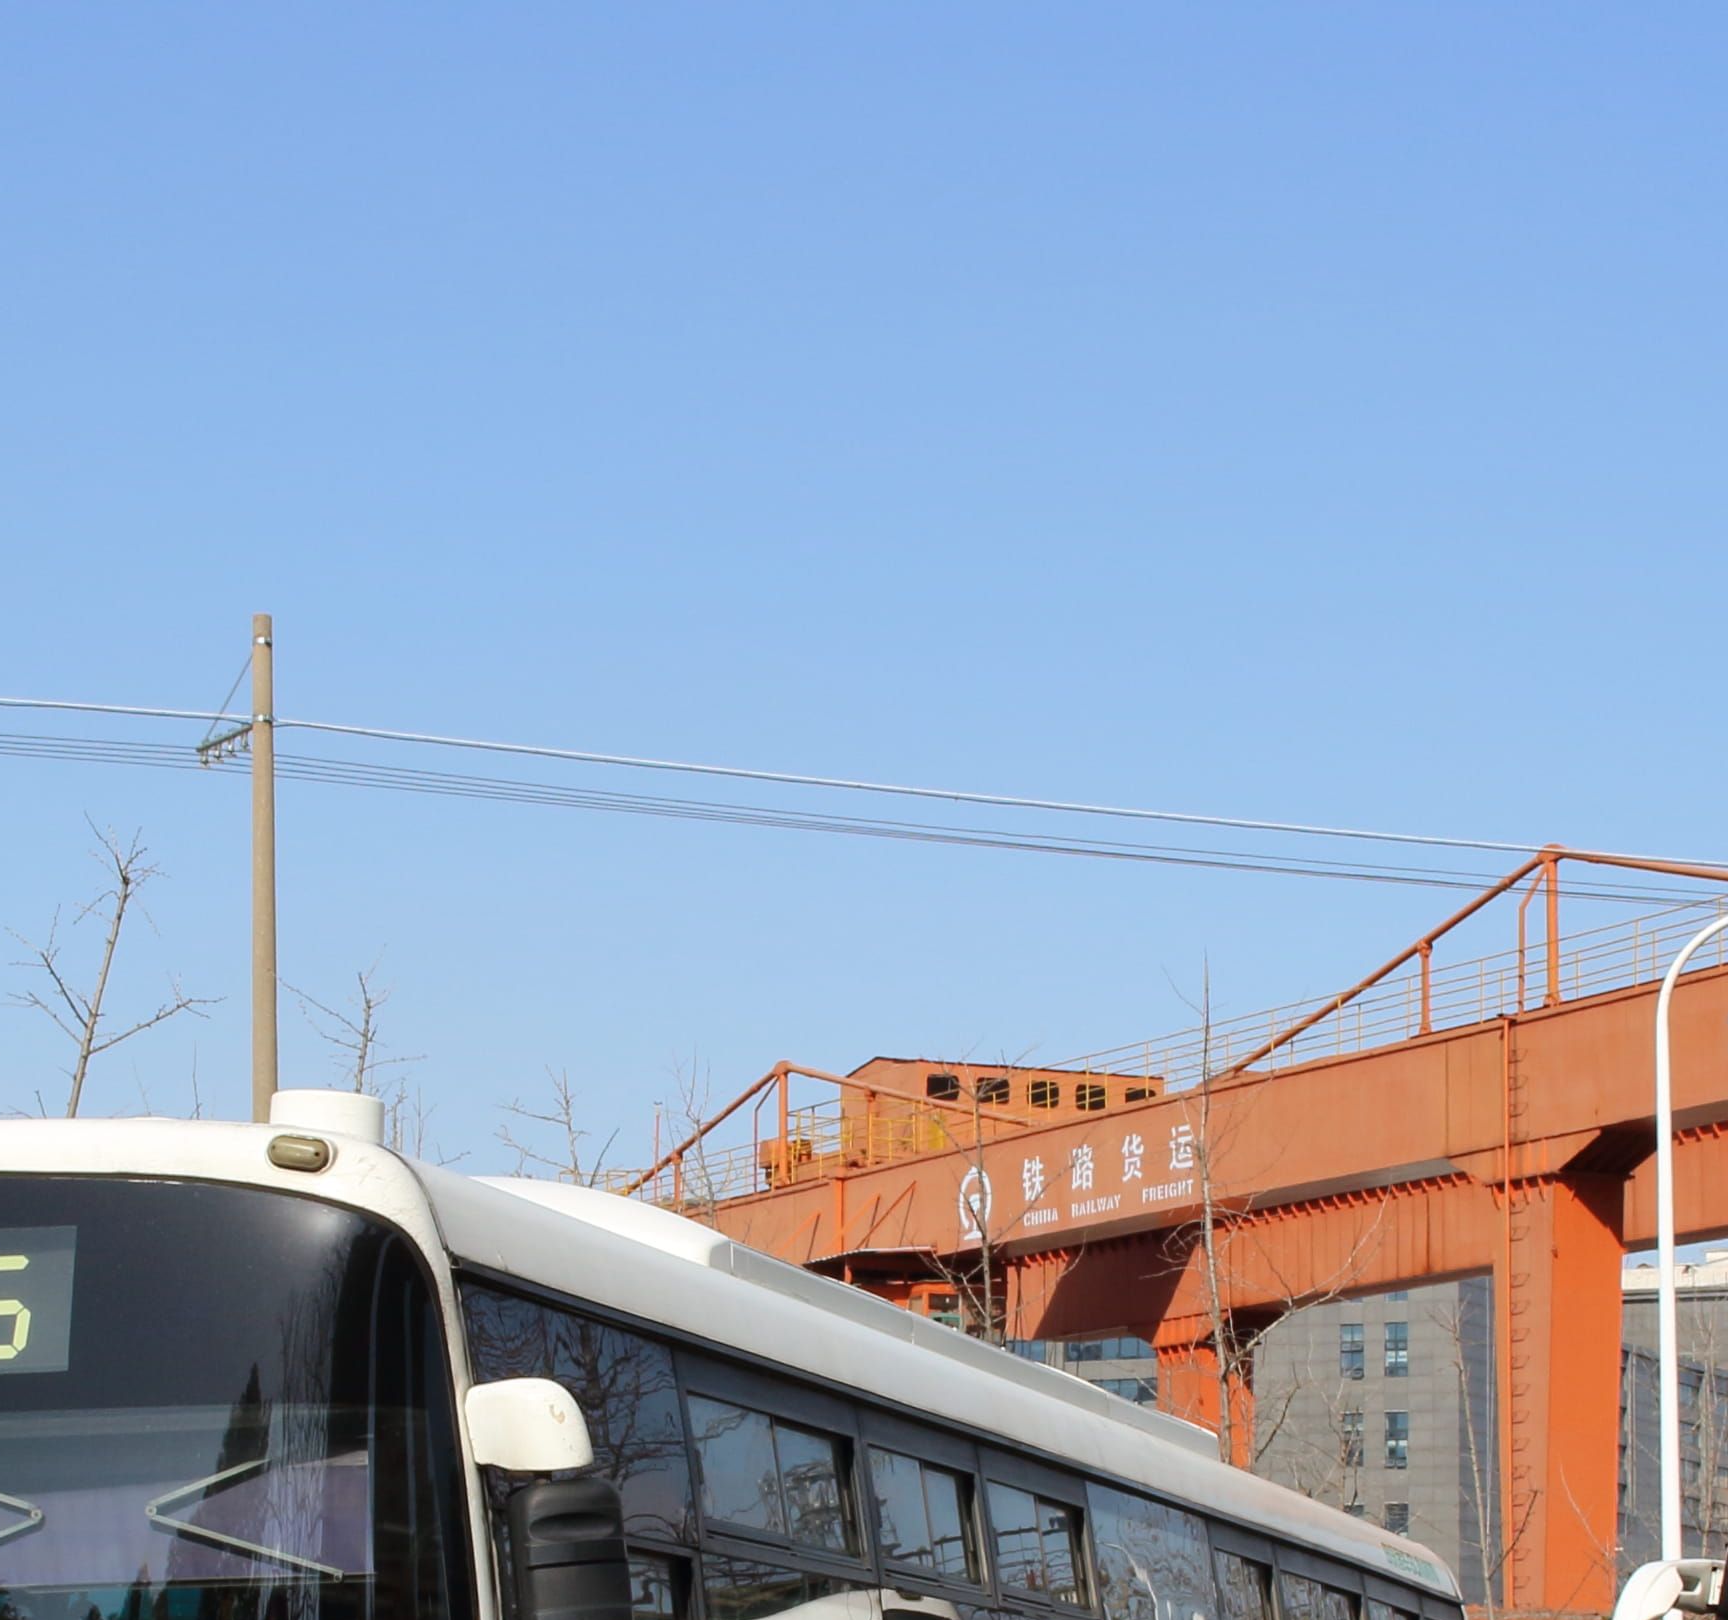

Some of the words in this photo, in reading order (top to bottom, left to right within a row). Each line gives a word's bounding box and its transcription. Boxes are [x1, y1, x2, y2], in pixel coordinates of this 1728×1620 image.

[1022, 1123, 1195, 1202] 铁路货运
[1071, 1194, 1121, 1218] RAILWAY
[1141, 1179, 1194, 1204] FREIGHT
